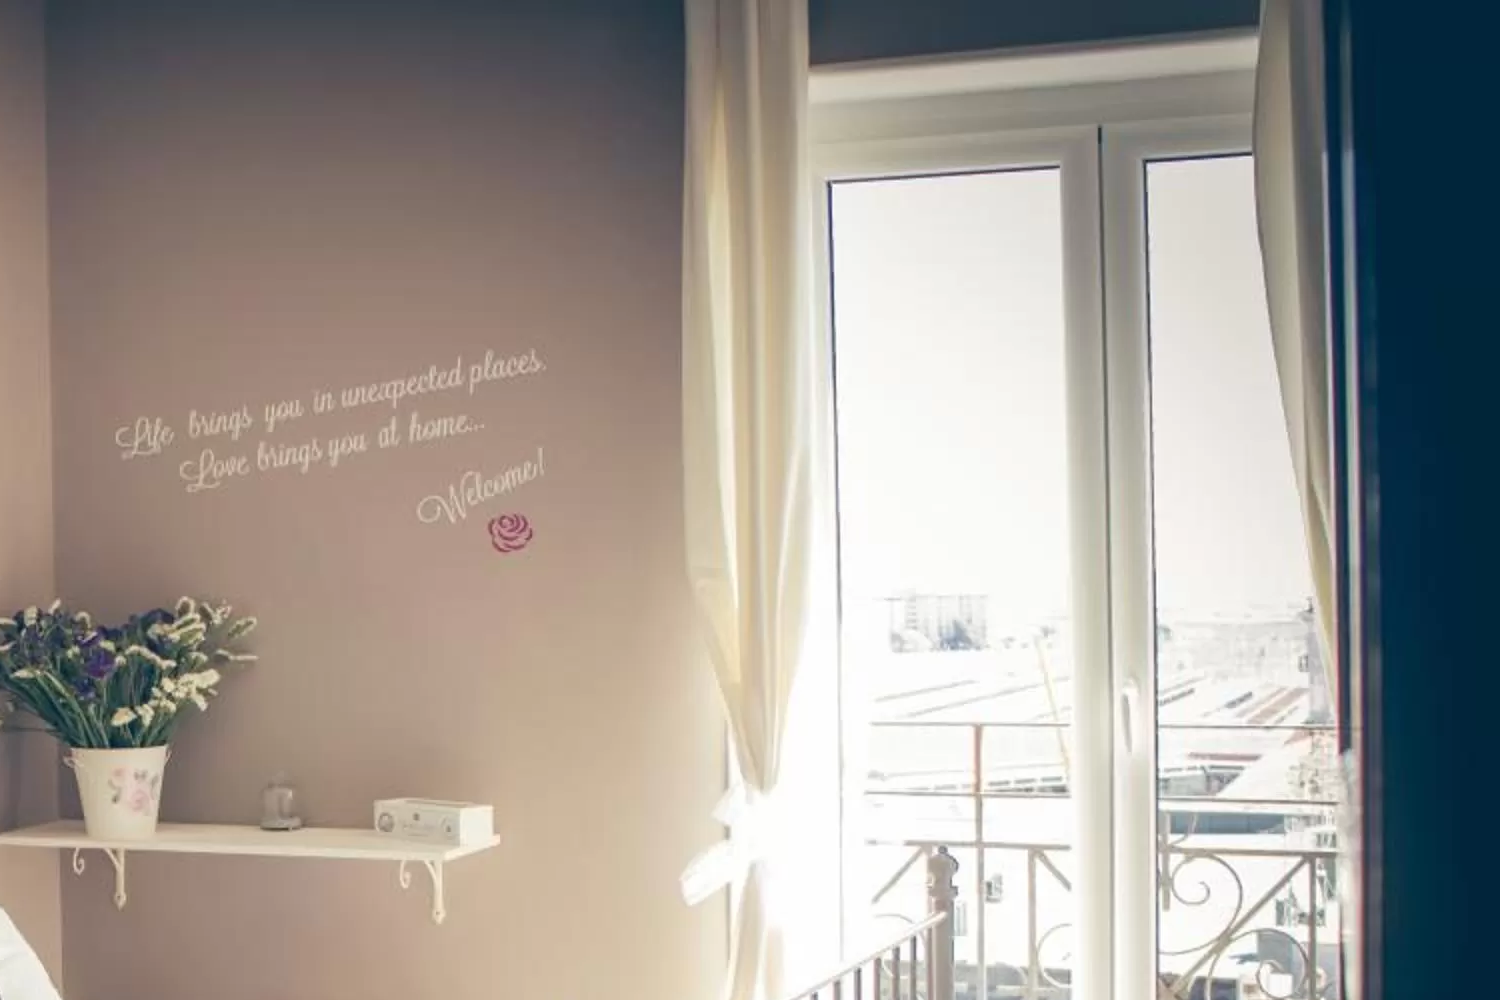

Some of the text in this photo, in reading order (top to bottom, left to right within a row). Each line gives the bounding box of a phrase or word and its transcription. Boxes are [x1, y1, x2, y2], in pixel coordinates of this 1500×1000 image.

[115, 349, 546, 459] Life brings you in unexpected places.
[179, 411, 485, 493] Love brings you at home...
[416, 447, 545, 523] Welcome!
